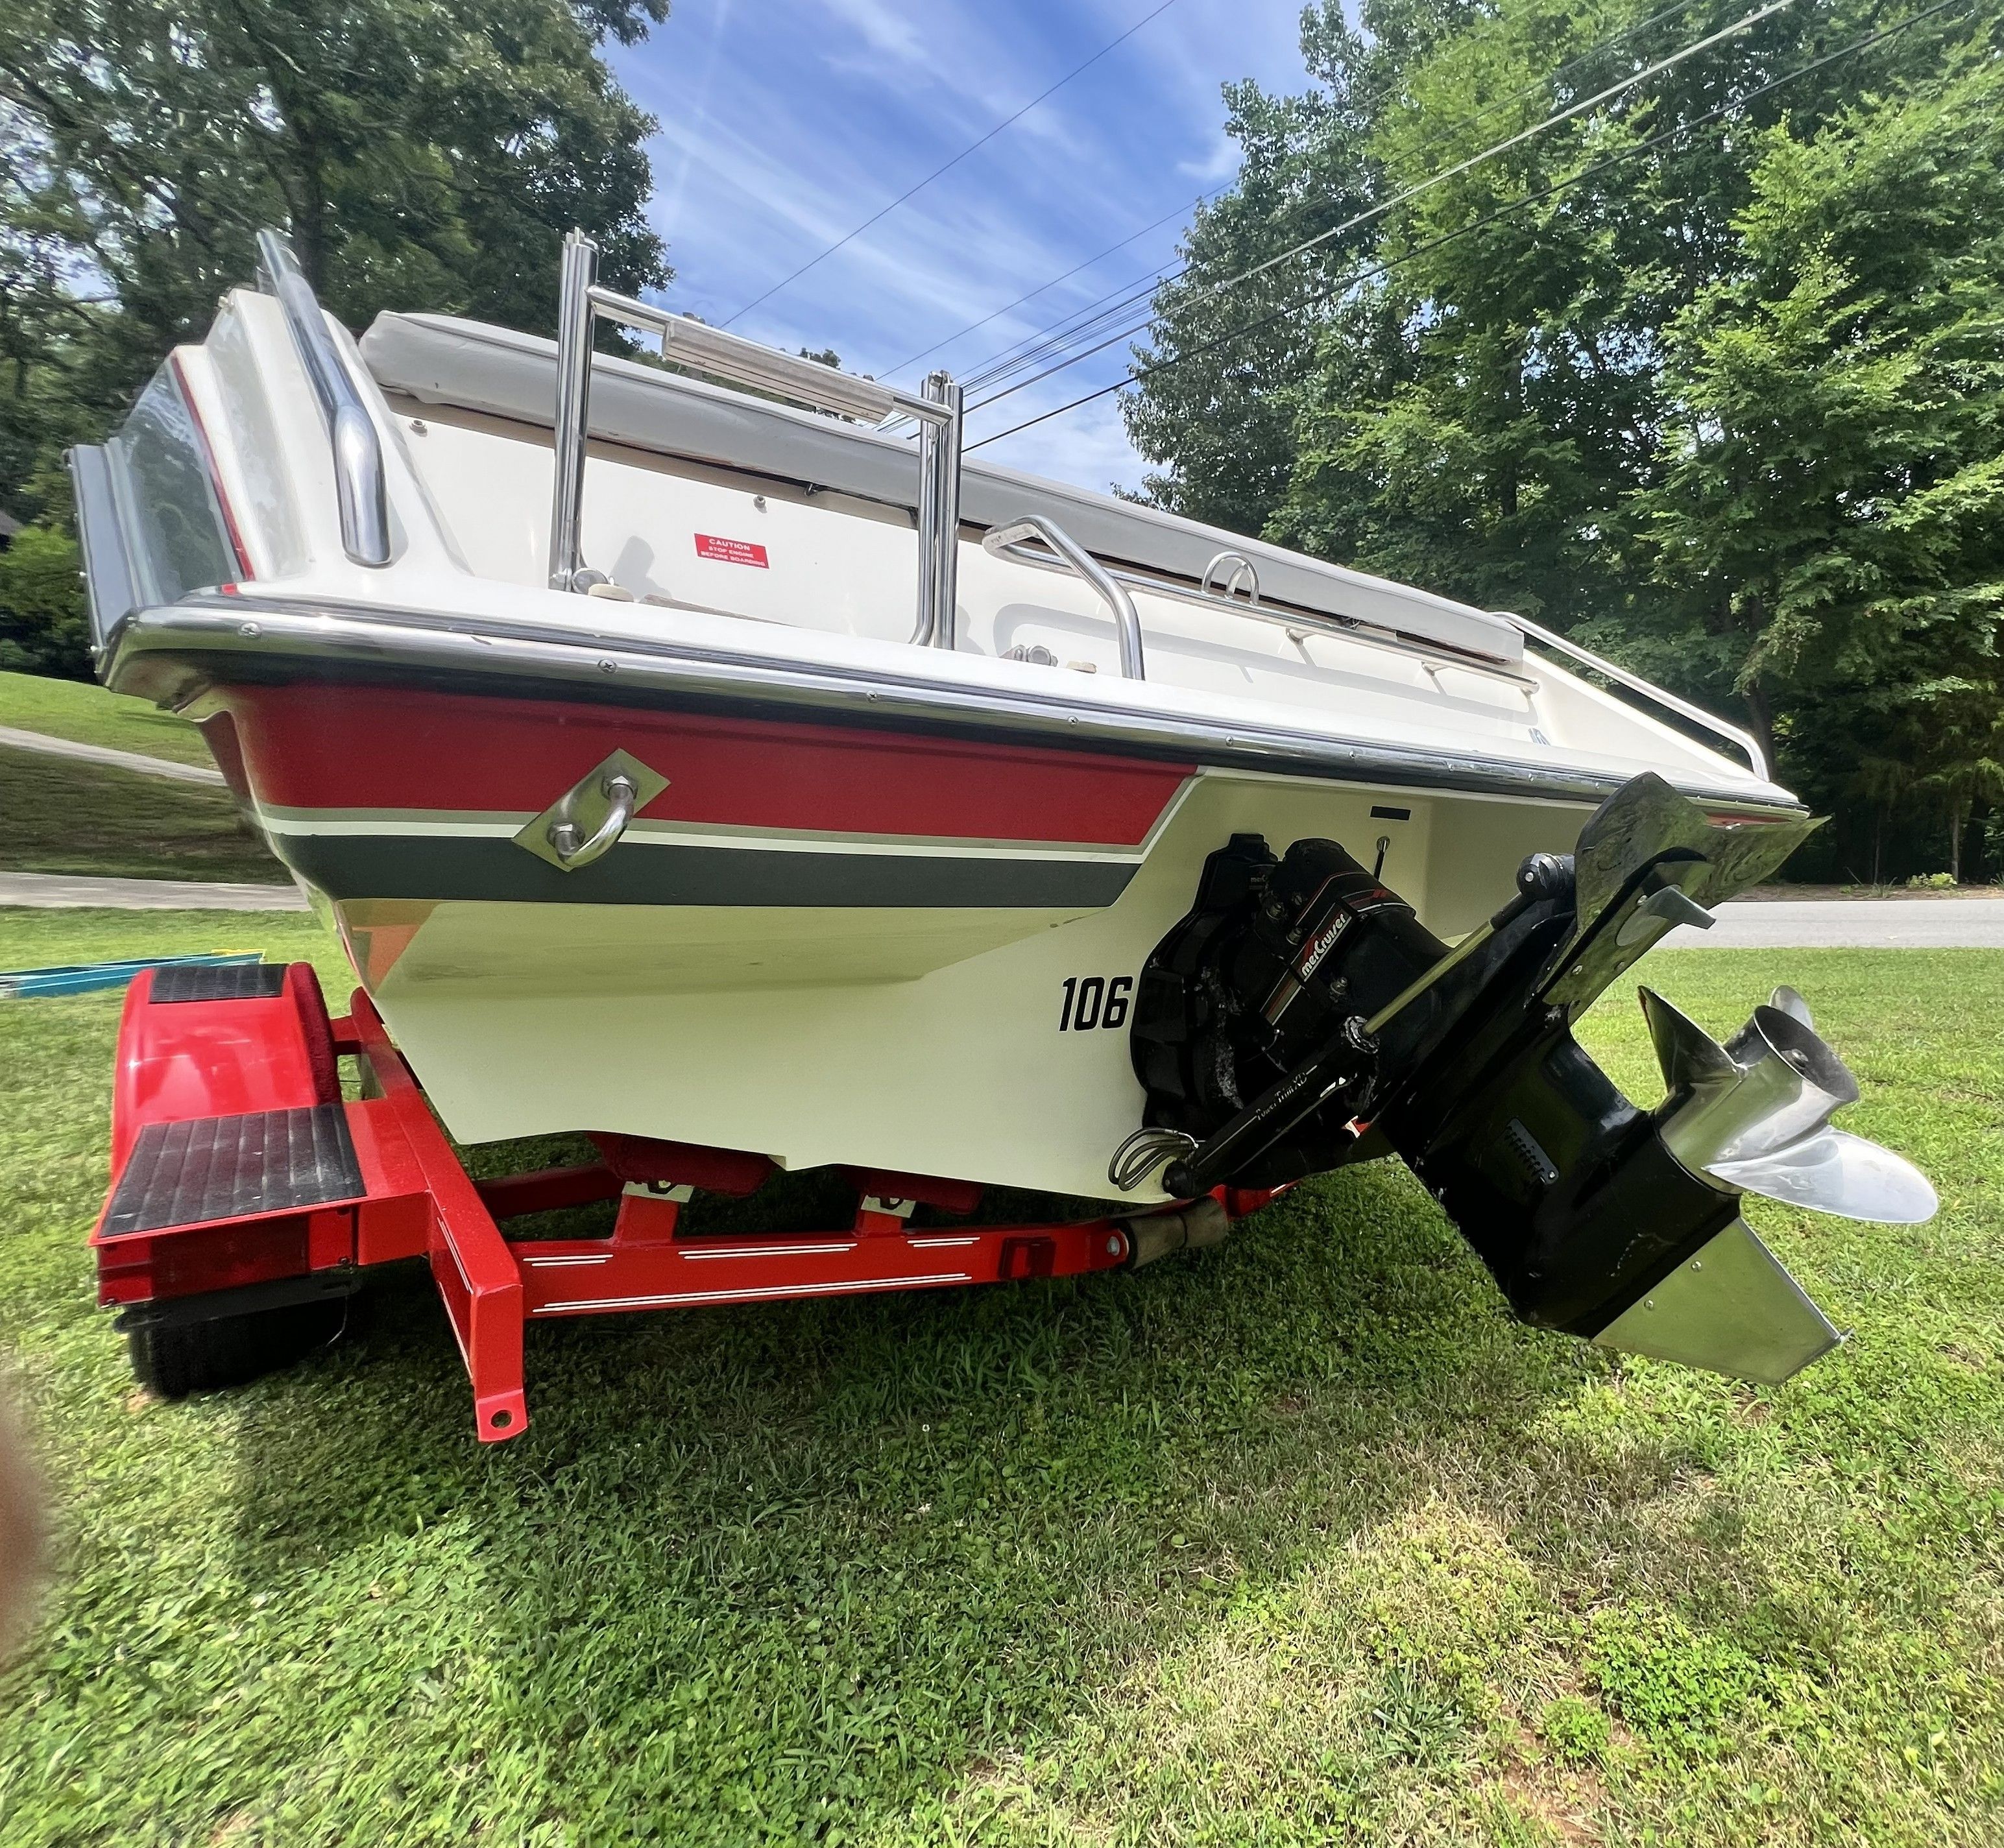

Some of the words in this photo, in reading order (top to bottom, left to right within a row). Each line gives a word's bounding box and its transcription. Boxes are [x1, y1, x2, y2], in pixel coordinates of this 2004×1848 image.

[708, 538, 751, 551] CAUTION
[700, 551, 729, 560] BEFORE
[730, 556, 766, 567] BOARDING
[729, 549, 755, 558] ENGINE
[1059, 976, 1133, 1031] 106
